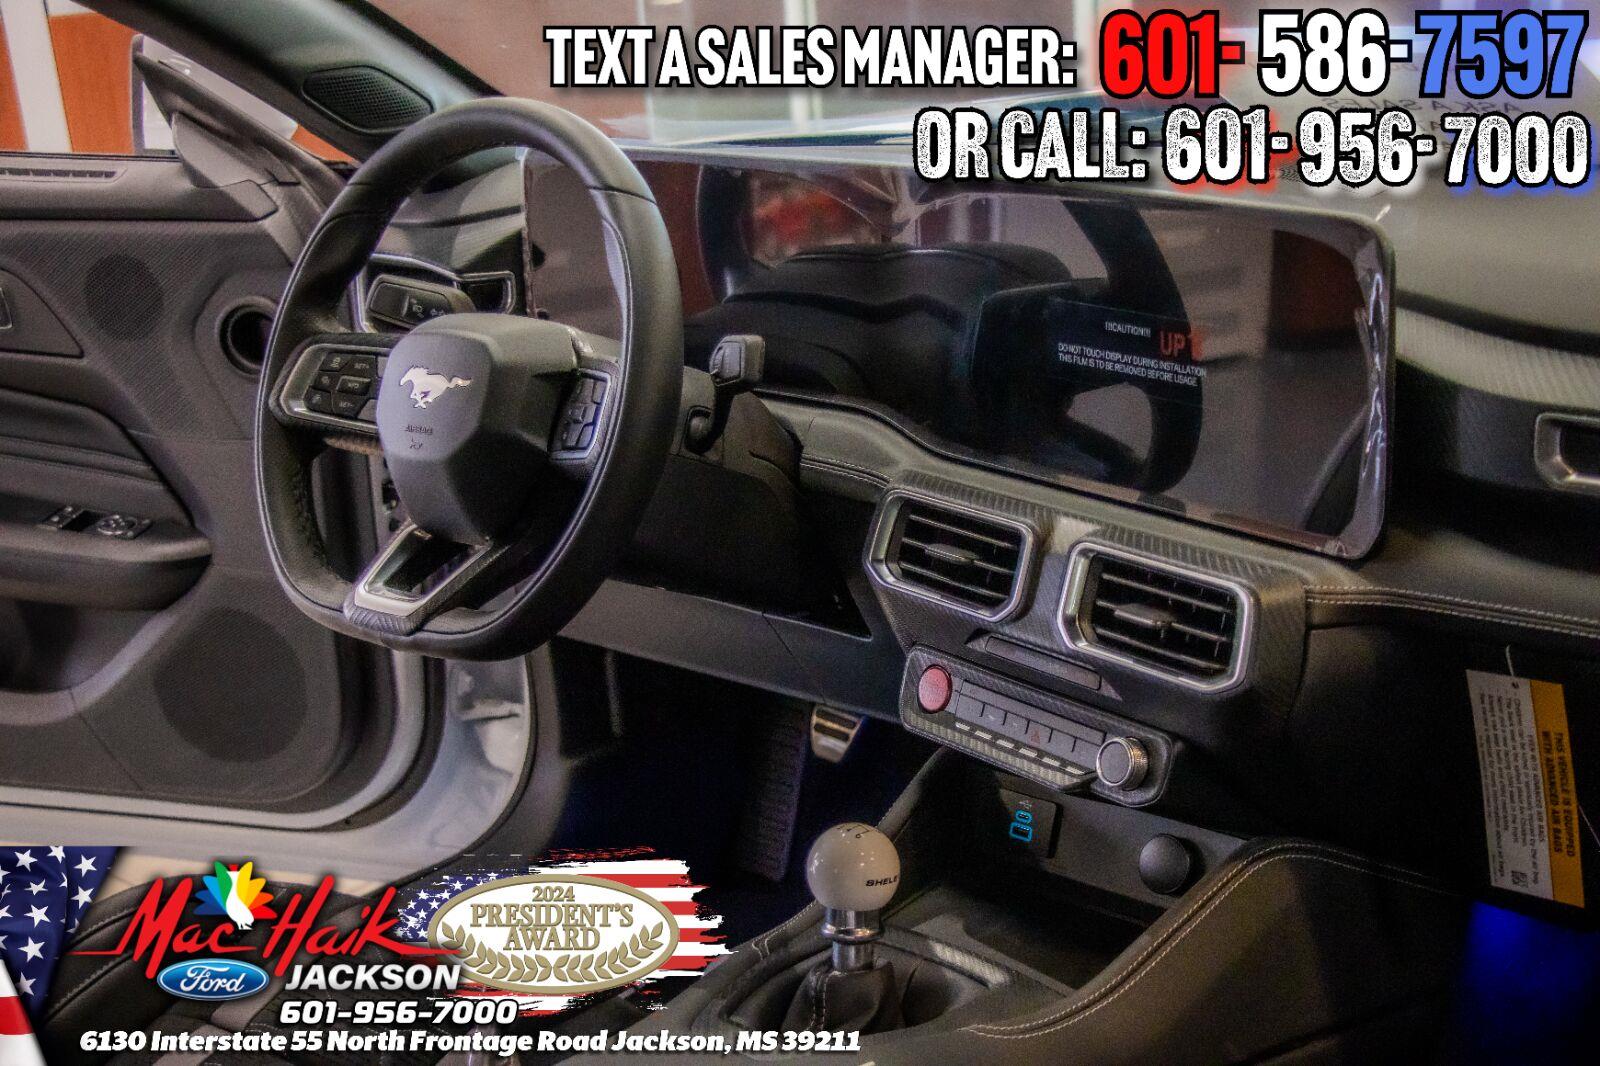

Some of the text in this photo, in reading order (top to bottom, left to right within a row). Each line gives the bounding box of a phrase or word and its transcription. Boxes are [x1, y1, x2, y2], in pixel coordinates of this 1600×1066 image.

[1160, 331, 1186, 357] UP
[1059, 352, 1073, 363] THIS
[1073, 355, 1088, 366] FILM
[1096, 359, 1105, 369] TO
[1105, 361, 1114, 371] BE
[1083, 346, 1105, 359] TOUCH
[1105, 350, 1132, 364] DISPLAY
[1132, 355, 1158, 369] DURING
[1160, 360, 1206, 378] INSTALLATION
[1557, 755, 1569, 794] VEHICLE
